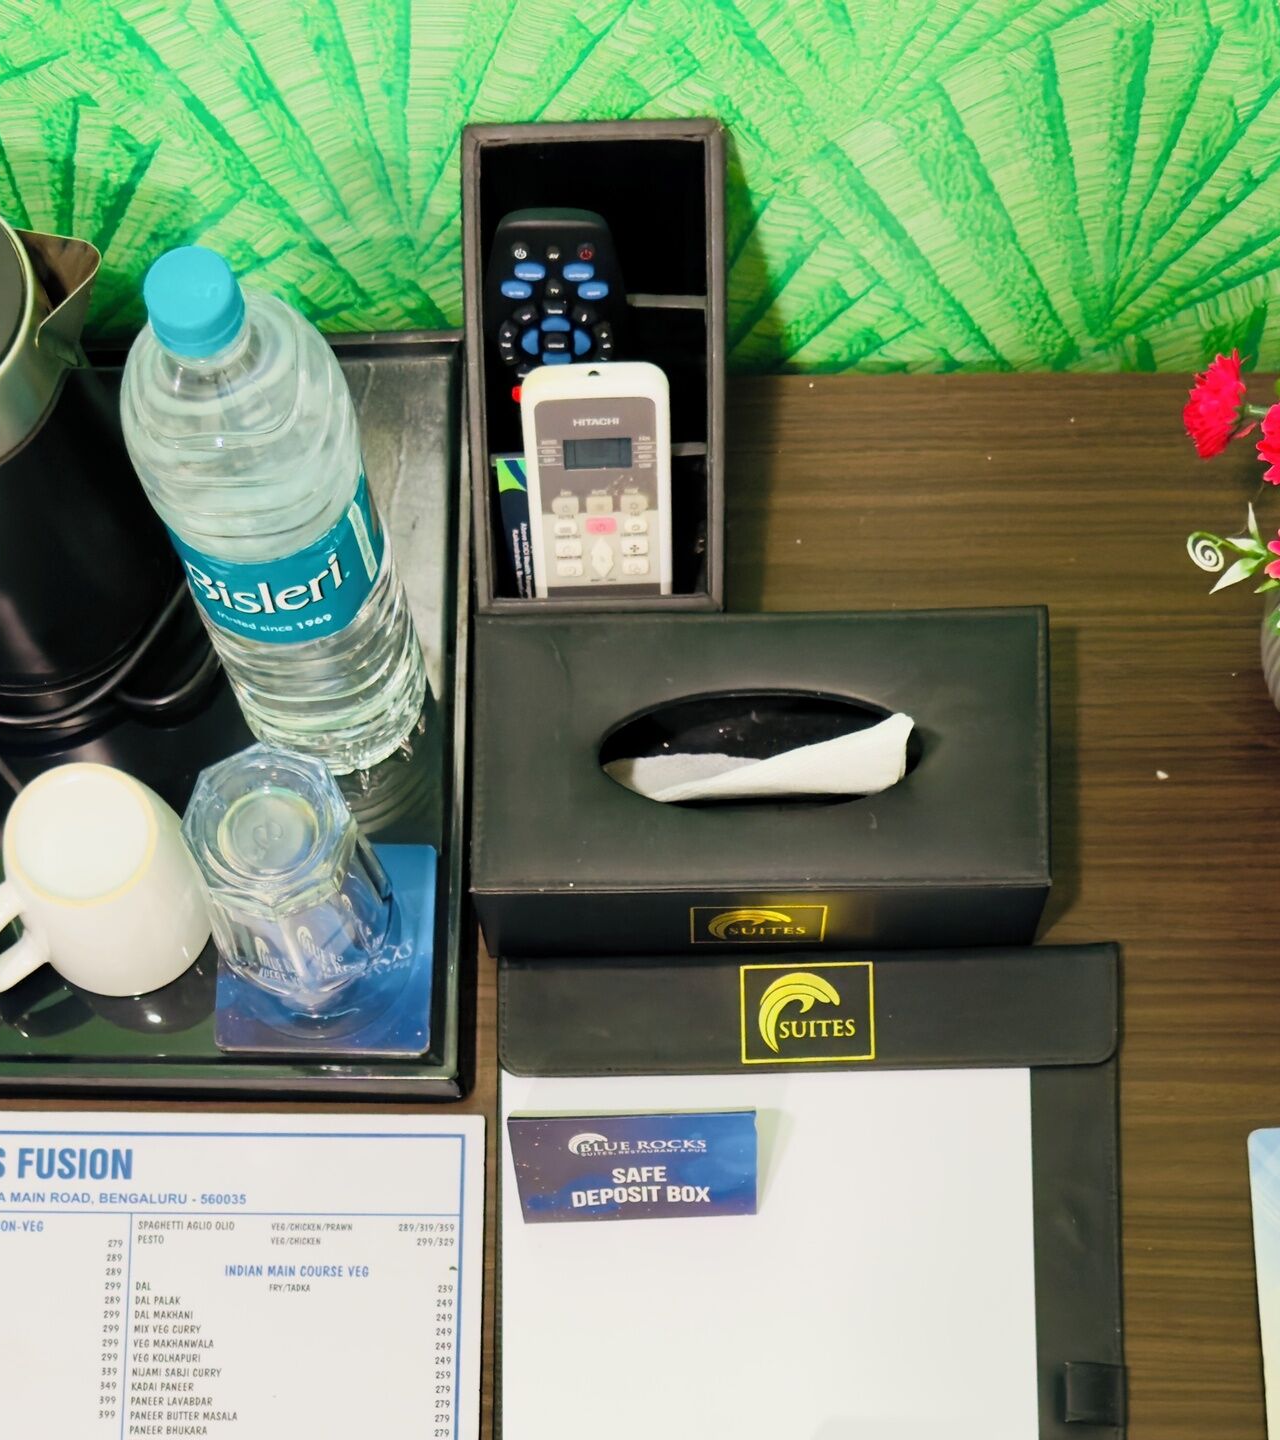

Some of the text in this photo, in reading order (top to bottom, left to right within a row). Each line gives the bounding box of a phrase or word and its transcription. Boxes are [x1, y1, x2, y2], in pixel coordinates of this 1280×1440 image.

[573, 418, 620, 427] HITACHI
[184, 552, 343, 614] Bisleri
[260, 623, 293, 632] since
[296, 613, 333, 630] 1969
[728, 926, 807, 935] SUITES
[779, 1018, 856, 1039] SUITES
[581, 1139, 707, 1153] BLUE ROCKS
[17, 1147, 133, 1180] FUSION
[612, 1166, 667, 1184] SAFE
[10, 1192, 46, 1203] MAIN
[50, 1192, 94, 1205] ROAD,
[98, 1192, 187, 1204] BENGALURU
[200, 1193, 246, 1205] 560035
[572, 1185, 711, 1208] DEPOSIT BOX
[106, 1253, 123, 1262] 289
[225, 1264, 369, 1278] INDIAN MAIN COURSE VEG
[104, 1295, 121, 1305] 289
[135, 1295, 453, 1308] DAL PALAK 249
[102, 1338, 119, 1347] 299
[131, 1382, 451, 1394] KADAI PANEER 279
[99, 1395, 117, 1405] 399
[130, 1411, 450, 1423] PANEER BUTTER MASALA 279
